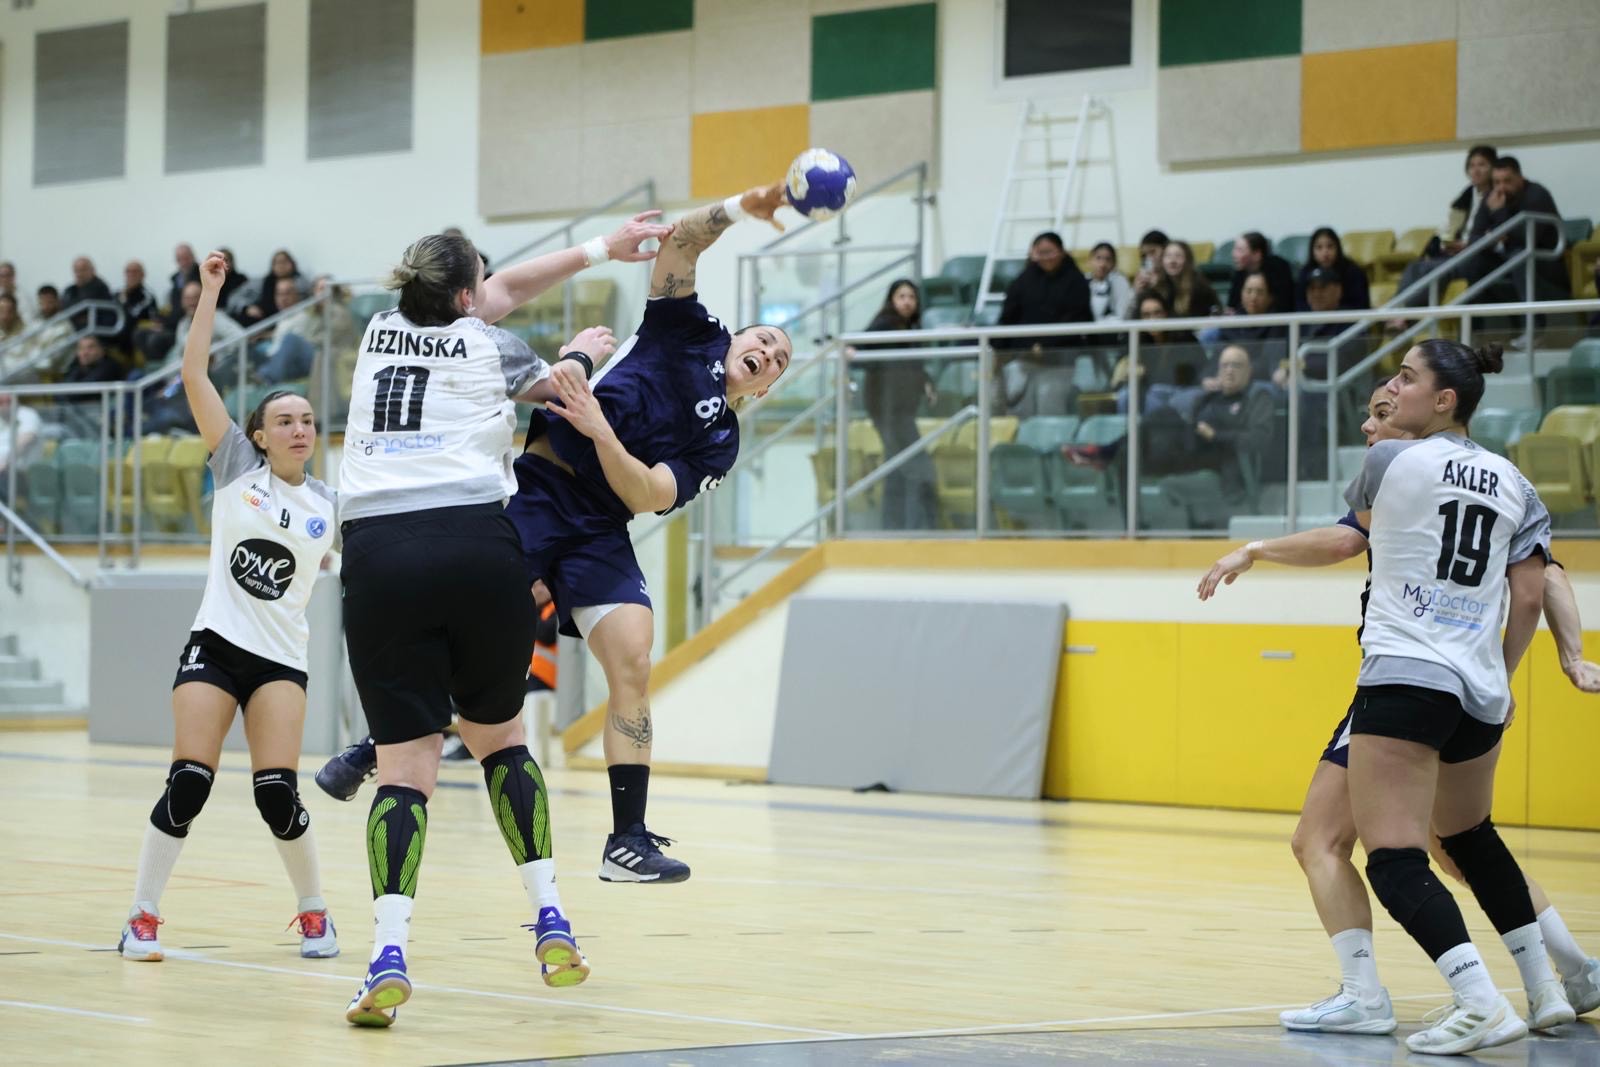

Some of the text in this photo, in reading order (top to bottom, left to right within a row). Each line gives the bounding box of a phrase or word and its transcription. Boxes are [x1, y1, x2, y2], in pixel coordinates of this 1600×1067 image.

[366, 329, 468, 359] LEZINSKA
[372, 365, 431, 433] 10
[1442, 459, 1499, 498] AKLER
[279, 508, 291, 530] 9
[1436, 499, 1499, 587] 19
[1448, 960, 1479, 979] adidas
